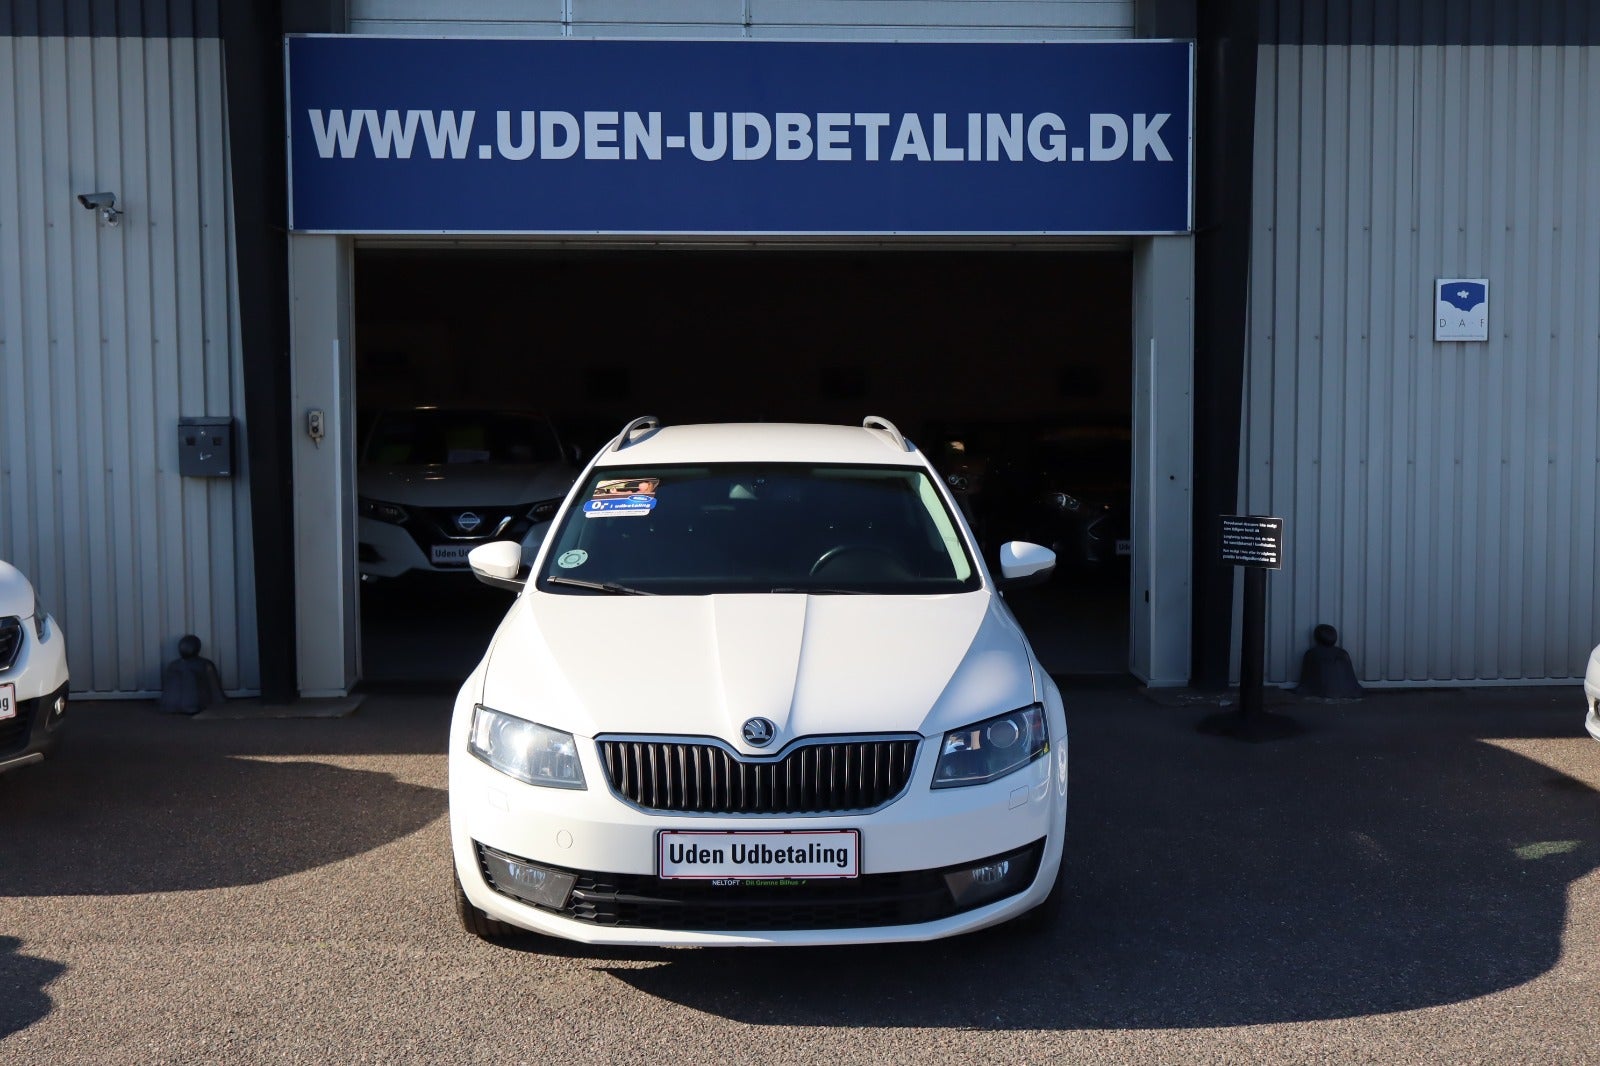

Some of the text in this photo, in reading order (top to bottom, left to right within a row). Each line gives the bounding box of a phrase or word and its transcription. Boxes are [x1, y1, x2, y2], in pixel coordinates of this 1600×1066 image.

[308, 109, 1173, 163] WWW.UDEN-UDBETALING.DK
[435, 549, 456, 557] Uden
[670, 843, 848, 868] Uden Udbetaling
